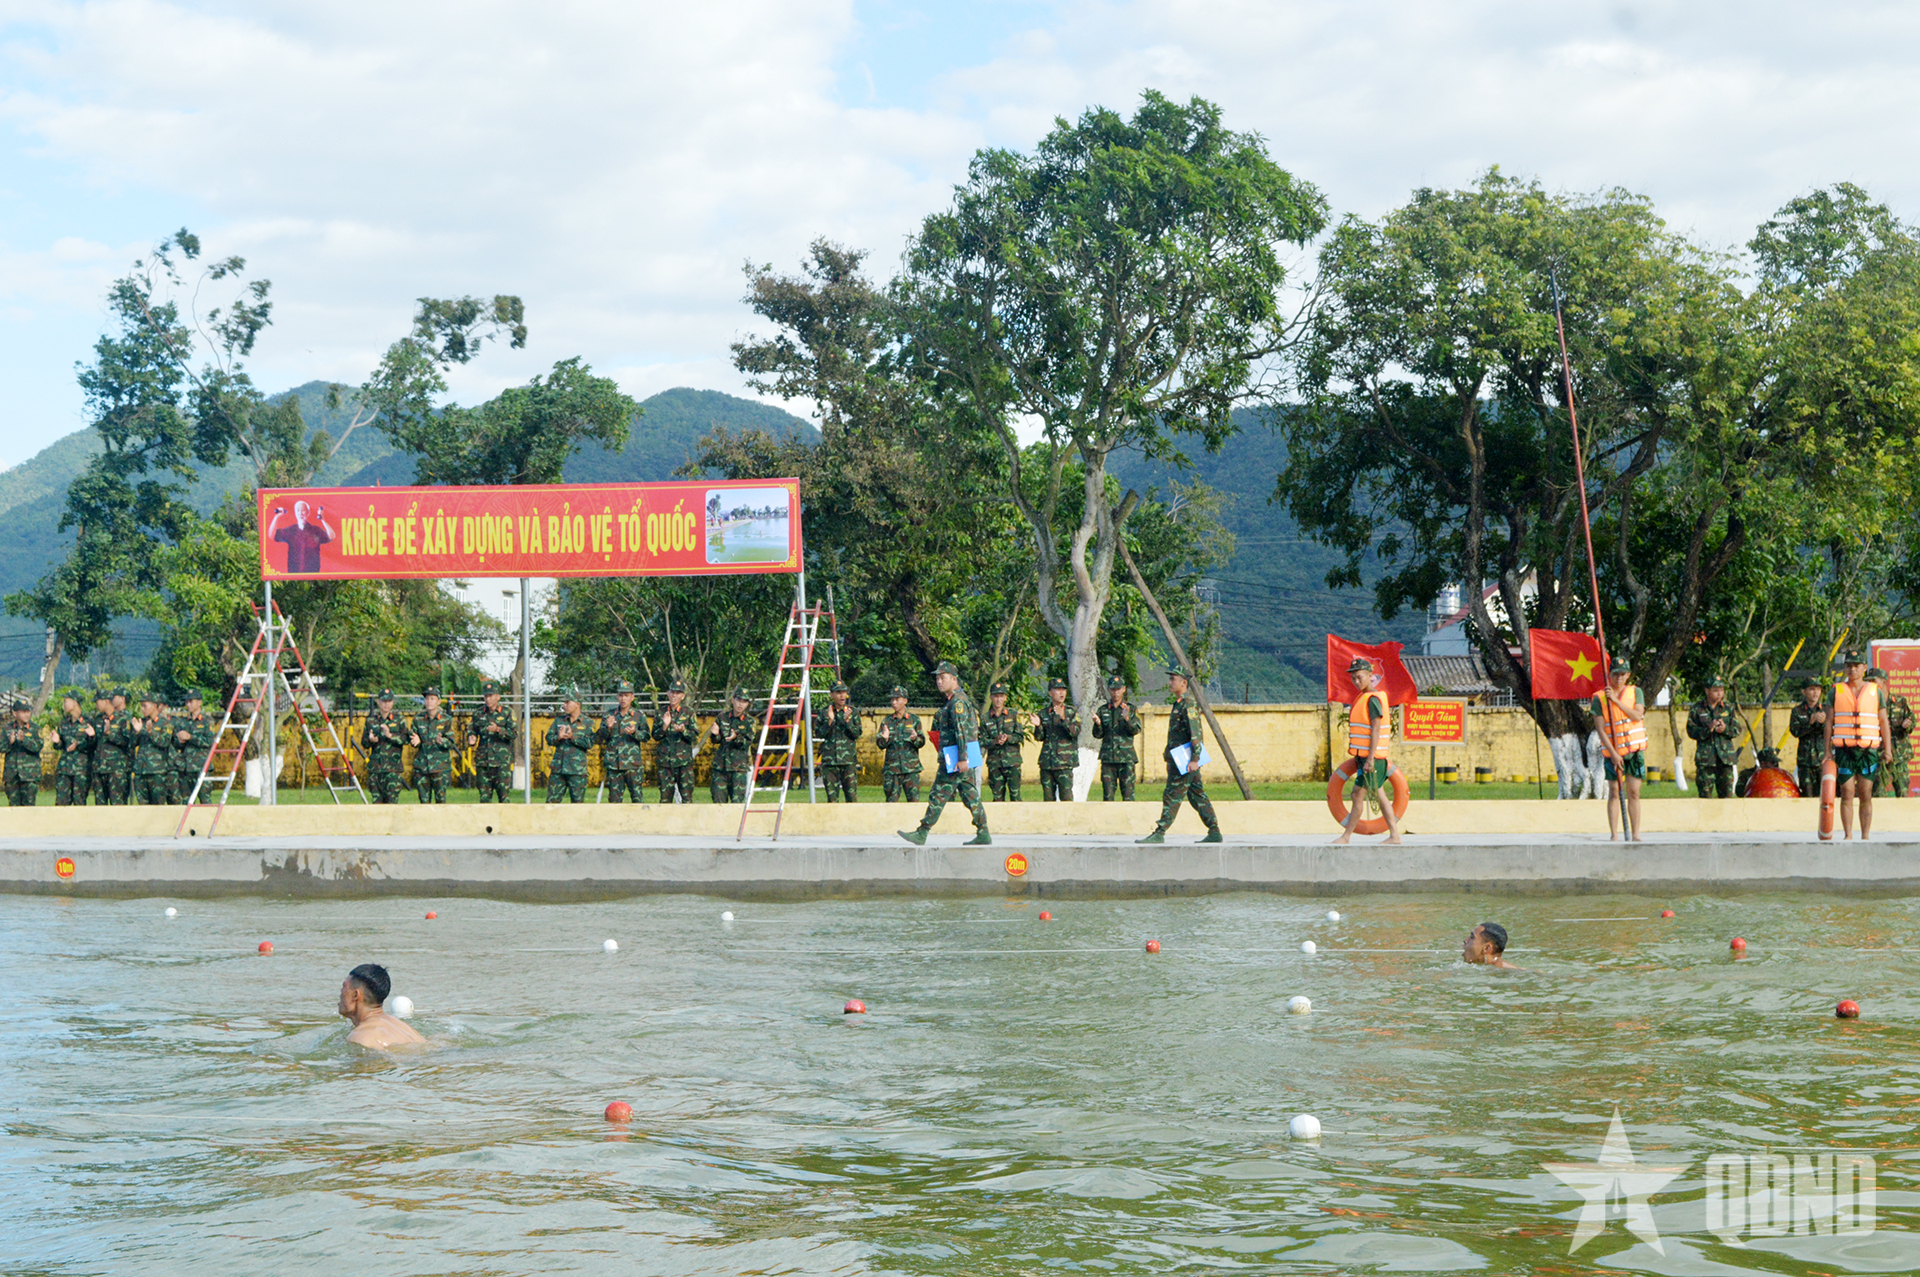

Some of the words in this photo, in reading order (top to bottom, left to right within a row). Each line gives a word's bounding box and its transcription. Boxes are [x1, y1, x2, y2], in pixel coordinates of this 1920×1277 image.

[341, 504, 388, 556] KHỎE
[393, 501, 417, 555] ĐỂ
[422, 508, 458, 555] XÂY
[463, 512, 513, 563] DỰNG
[518, 508, 543, 554] VÀ
[548, 502, 585, 554] BẢO
[590, 506, 613, 561] VỆ
[618, 498, 642, 553] TỔ
[647, 498, 697, 557] QUỐC
[1410, 710, 1434, 722] Quyết
[58, 861, 74, 874] 10m
[1008, 857, 1026, 871] 20m
